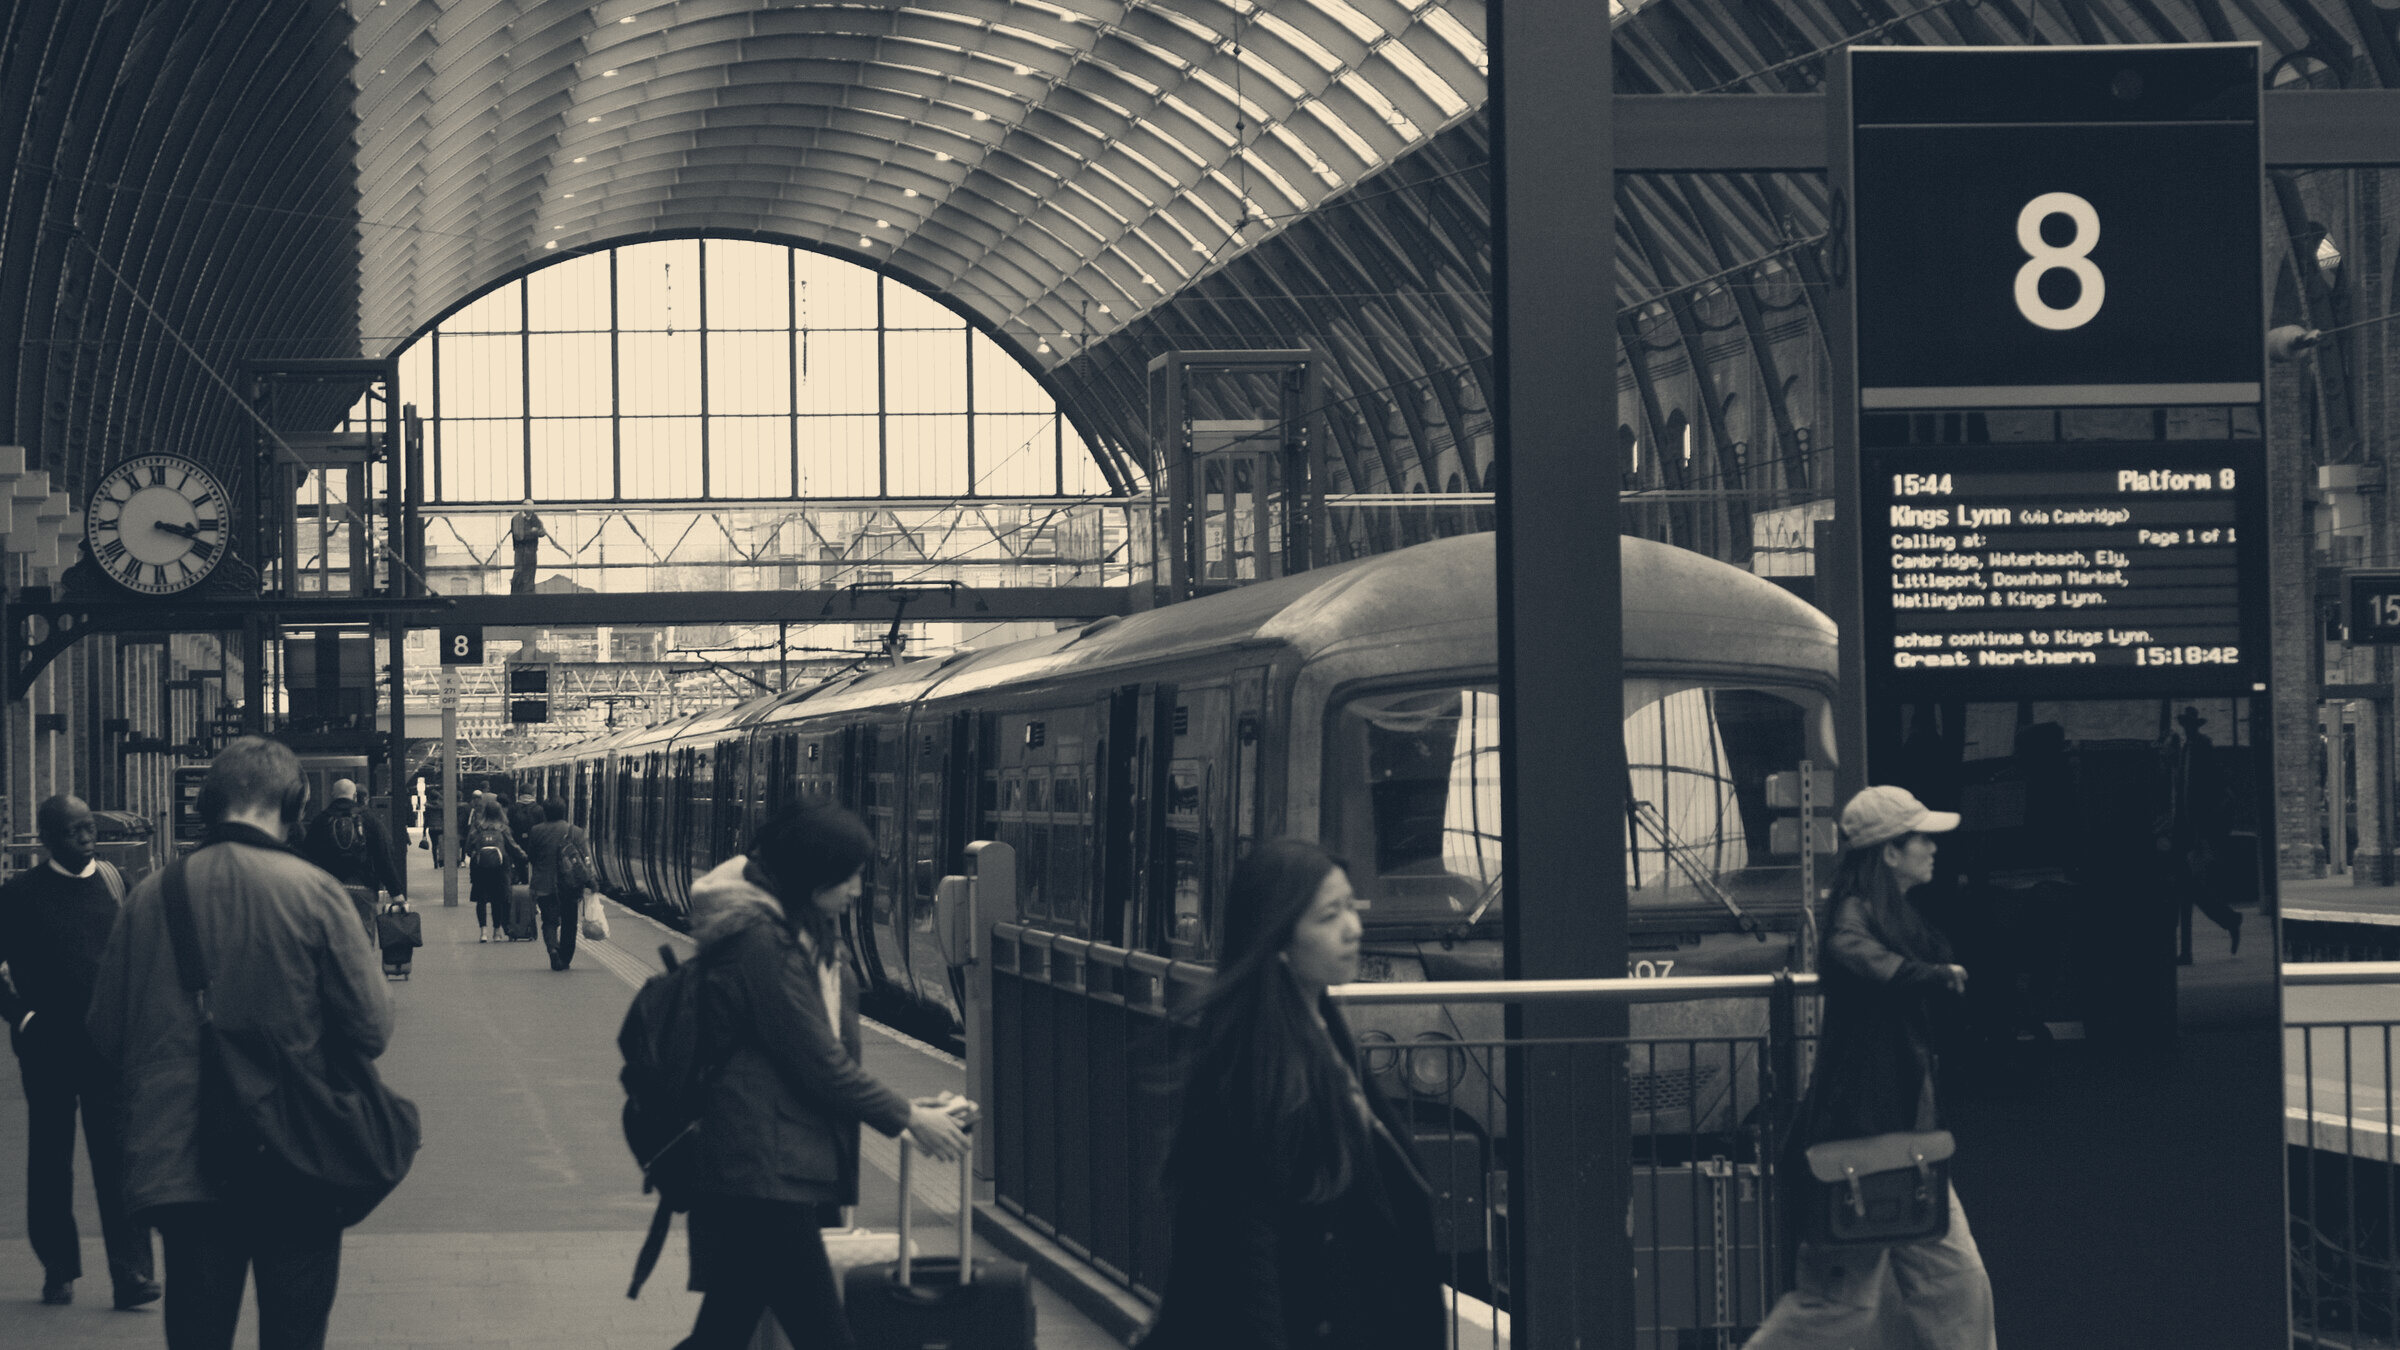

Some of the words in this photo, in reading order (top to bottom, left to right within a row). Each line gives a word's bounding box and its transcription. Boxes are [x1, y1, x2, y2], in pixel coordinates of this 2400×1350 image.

[2014, 192, 2105, 330] 8
[1893, 473, 1953, 496] 15:44
[2117, 470, 2212, 492] Platform
[2219, 468, 2236, 490] 8
[1890, 505, 1950, 530] Kings
[1957, 504, 2012, 529] Lynn
[2053, 508, 2130, 526] Cambridge)
[1891, 533, 1956, 551] Calling
[1962, 532, 1987, 548] at:
[2138, 529, 2180, 547] Page
[2186, 529, 2195, 544] 1
[2200, 528, 2221, 544] of
[2227, 528, 2236, 543] 1
[1891, 553, 1985, 571] Cambridge,
[1989, 552, 2091, 568] Waterbeach,
[2095, 550, 2130, 567] Ely,
[1892, 573, 1988, 590] Littleport,
[1992, 571, 2063, 587] Downham
[2067, 570, 2129, 588] Market,
[1892, 592, 1985, 610] Watlington
[1990, 591, 2003, 606] &
[2007, 592, 2057, 609] Kings
[2061, 590, 2107, 608] Lynn.
[454, 635, 469, 656] 8
[1948, 631, 2024, 647] continue
[2029, 629, 2050, 645] to
[2054, 629, 2104, 647] Kings
[2108, 628, 2154, 647] Lynn.
[1894, 650, 1971, 668] Great
[1978, 649, 2097, 666] Northern
[2136, 646, 2239, 666] 15:18:42
[1628, 960, 1675, 978] 07
